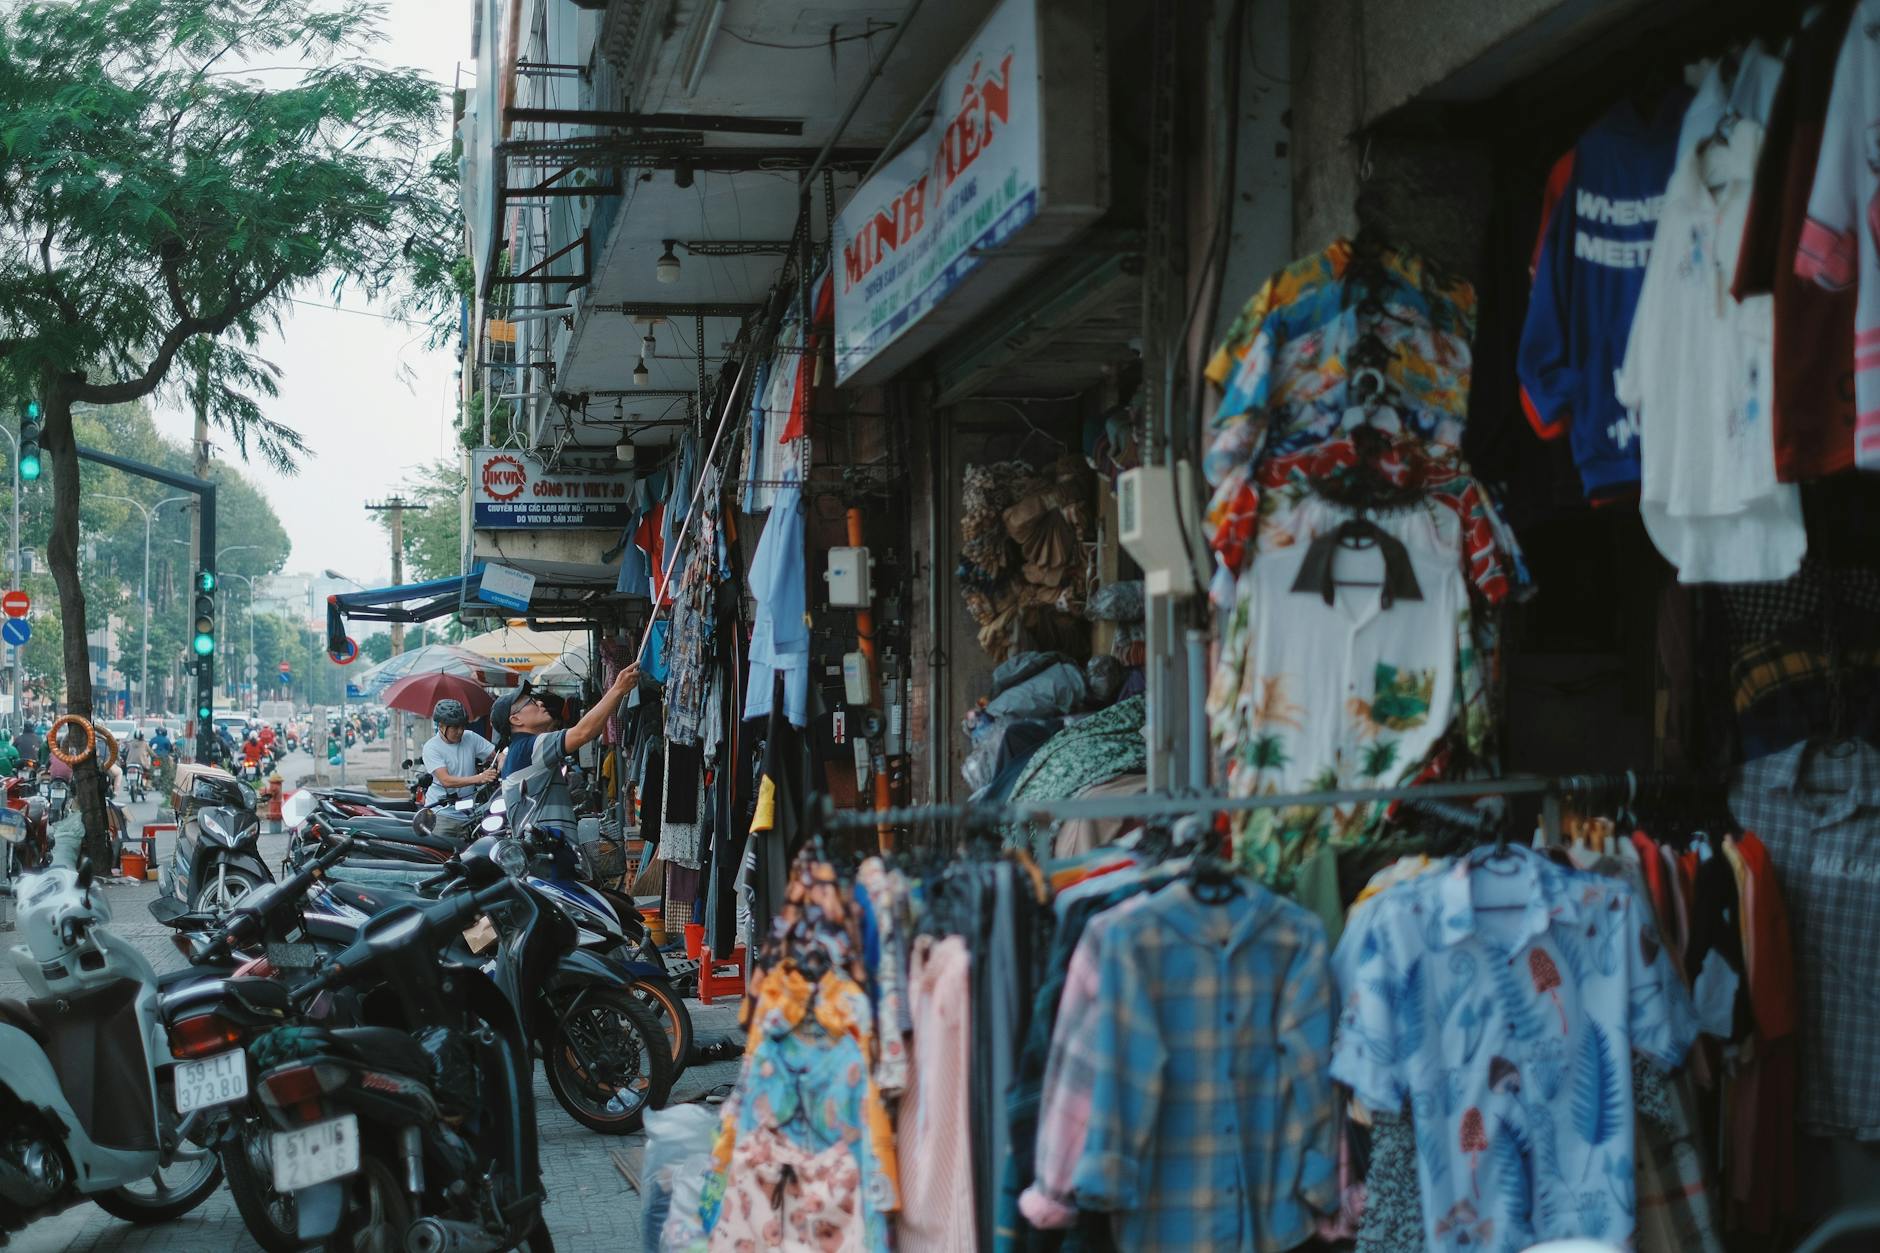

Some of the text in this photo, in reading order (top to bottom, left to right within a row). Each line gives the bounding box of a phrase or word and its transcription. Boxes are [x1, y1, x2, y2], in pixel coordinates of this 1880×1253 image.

[843, 174, 928, 295] MINH
[532, 480, 563, 497] CÔNG
[565, 482, 580, 498] TY
[487, 503, 513, 513] CHUYÊN
[516, 515, 527, 523] DO
[186, 1055, 233, 1085] 59-L1
[182, 1075, 242, 1108] 373.80
